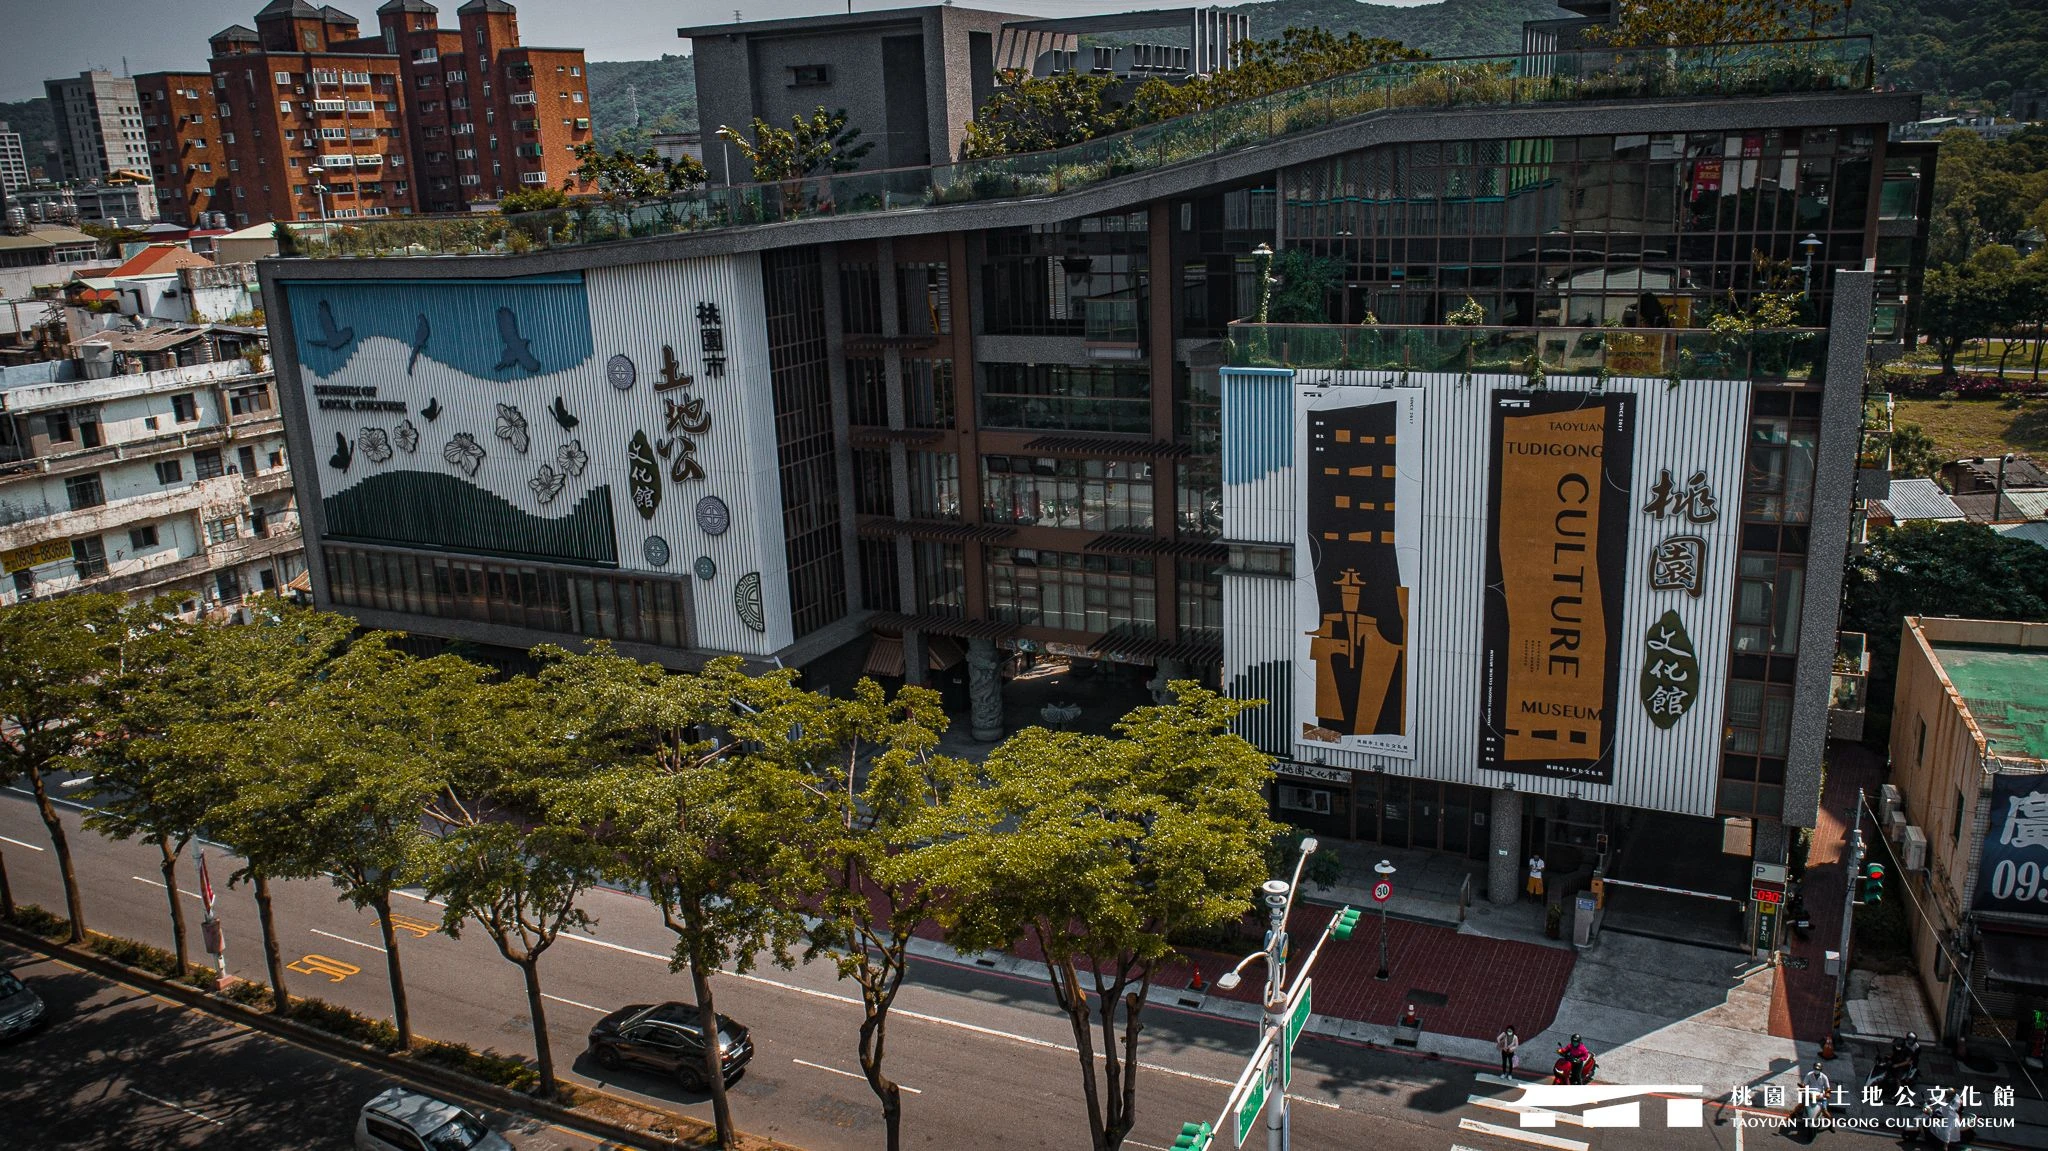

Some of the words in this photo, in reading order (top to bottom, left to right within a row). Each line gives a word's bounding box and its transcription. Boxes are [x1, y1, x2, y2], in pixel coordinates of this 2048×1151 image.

[696, 301, 726, 379] 桃園市
[654, 344, 712, 484] 土地公
[1549, 421, 1604, 432] TAOYUAN
[1505, 441, 1604, 458] TUDIGONG
[627, 441, 655, 508] 文化館
[1643, 470, 1718, 600] 桃園
[1548, 472, 1590, 678] CULTURE
[1647, 626, 1692, 715] 文化館
[1521, 700, 1602, 721] MUSEUM
[1377, 885, 1389, 897] 30
[1756, 866, 1766, 877] P
[287, 954, 361, 982] 50
